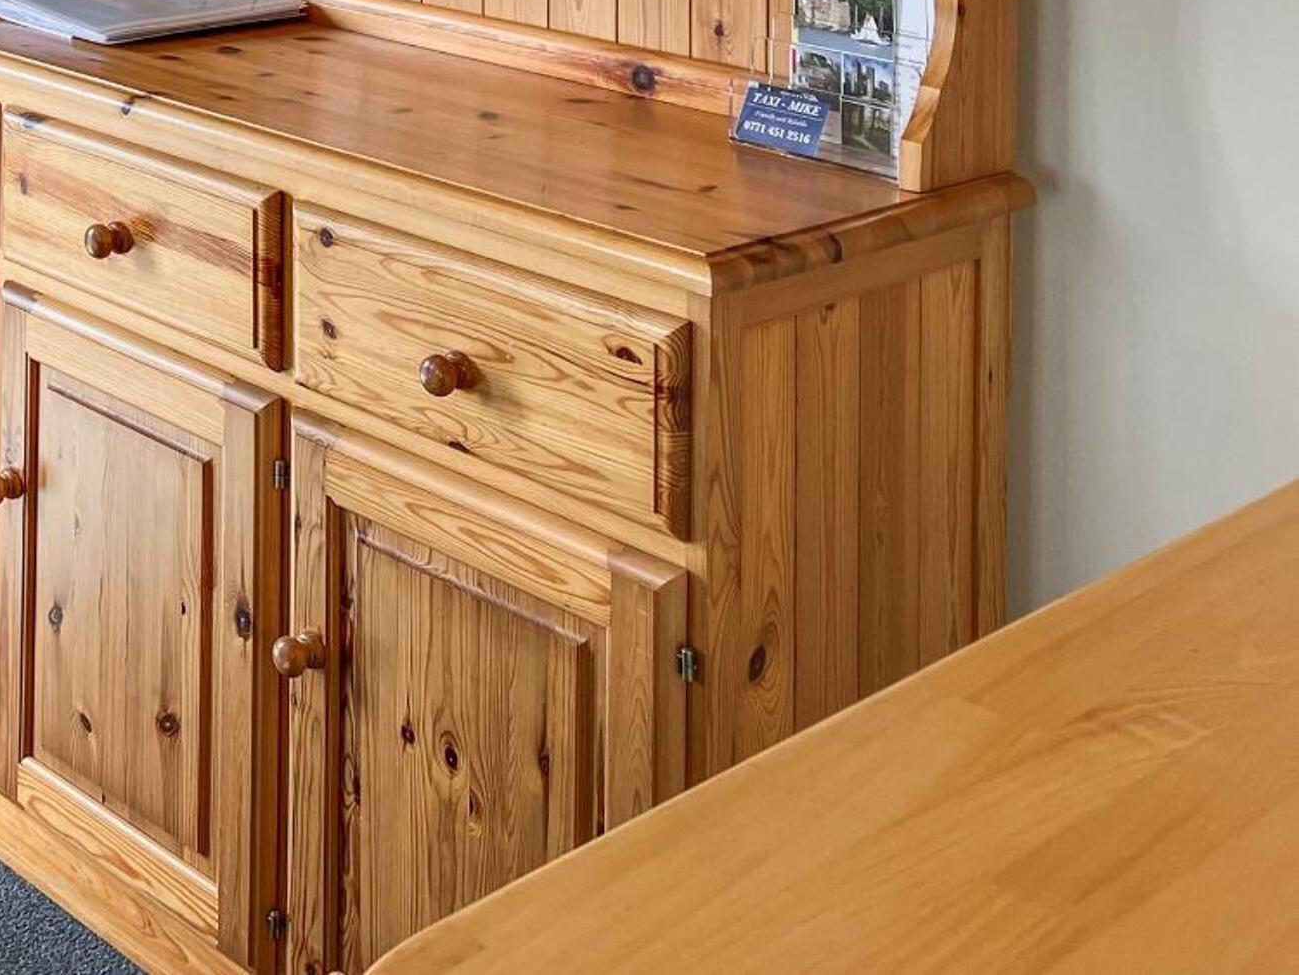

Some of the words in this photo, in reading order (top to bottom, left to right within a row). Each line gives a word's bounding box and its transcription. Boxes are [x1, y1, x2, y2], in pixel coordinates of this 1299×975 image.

[752, 92, 782, 108] TAXI
[787, 100, 822, 117] MIKE
[743, 120, 767, 134] 0771
[786, 129, 811, 144] 2516
